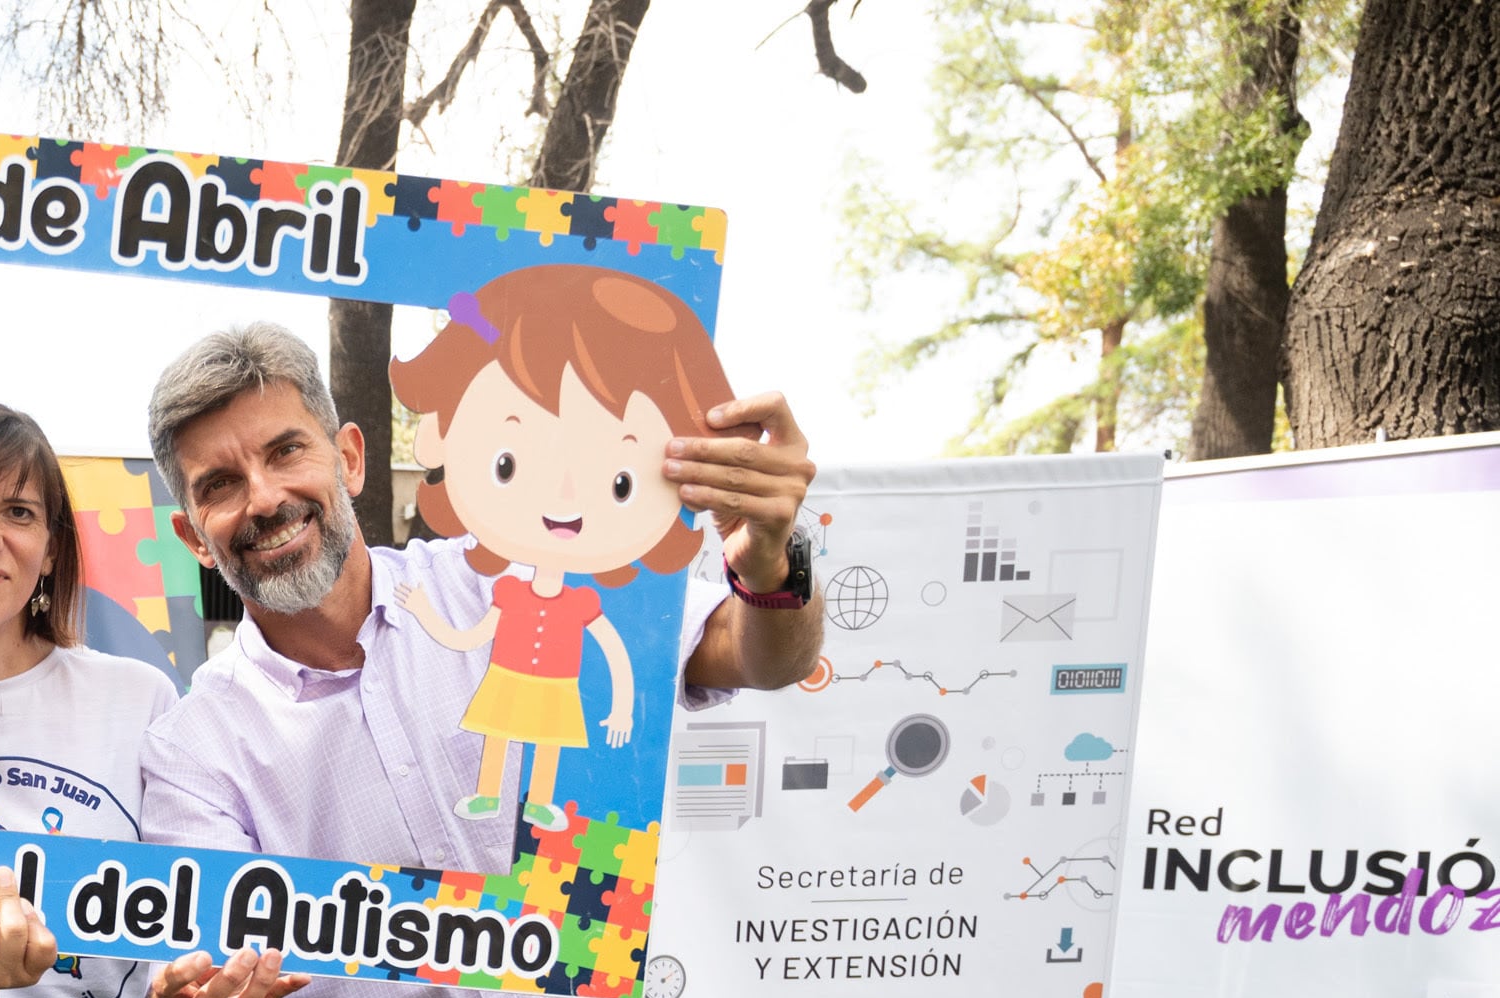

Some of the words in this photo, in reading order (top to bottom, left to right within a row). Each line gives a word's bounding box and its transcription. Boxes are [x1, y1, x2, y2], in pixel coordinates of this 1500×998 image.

[117, 159, 362, 279] Abril
[6, 766, 47, 790] San
[49, 775, 102, 811] Juan
[1146, 806, 1224, 837] Red
[757, 862, 917, 890] Secretaría
[928, 861, 964, 886] de
[1142, 838, 1497, 898] INCLUSIÓ
[72, 862, 195, 944] del
[225, 865, 553, 973] Autismo
[735, 909, 978, 943] INVESTIGACIÓN
[1216, 867, 1500, 944] mendoz
[754, 957, 772, 980] Y
[783, 948, 962, 980] EXTENSIÓN
